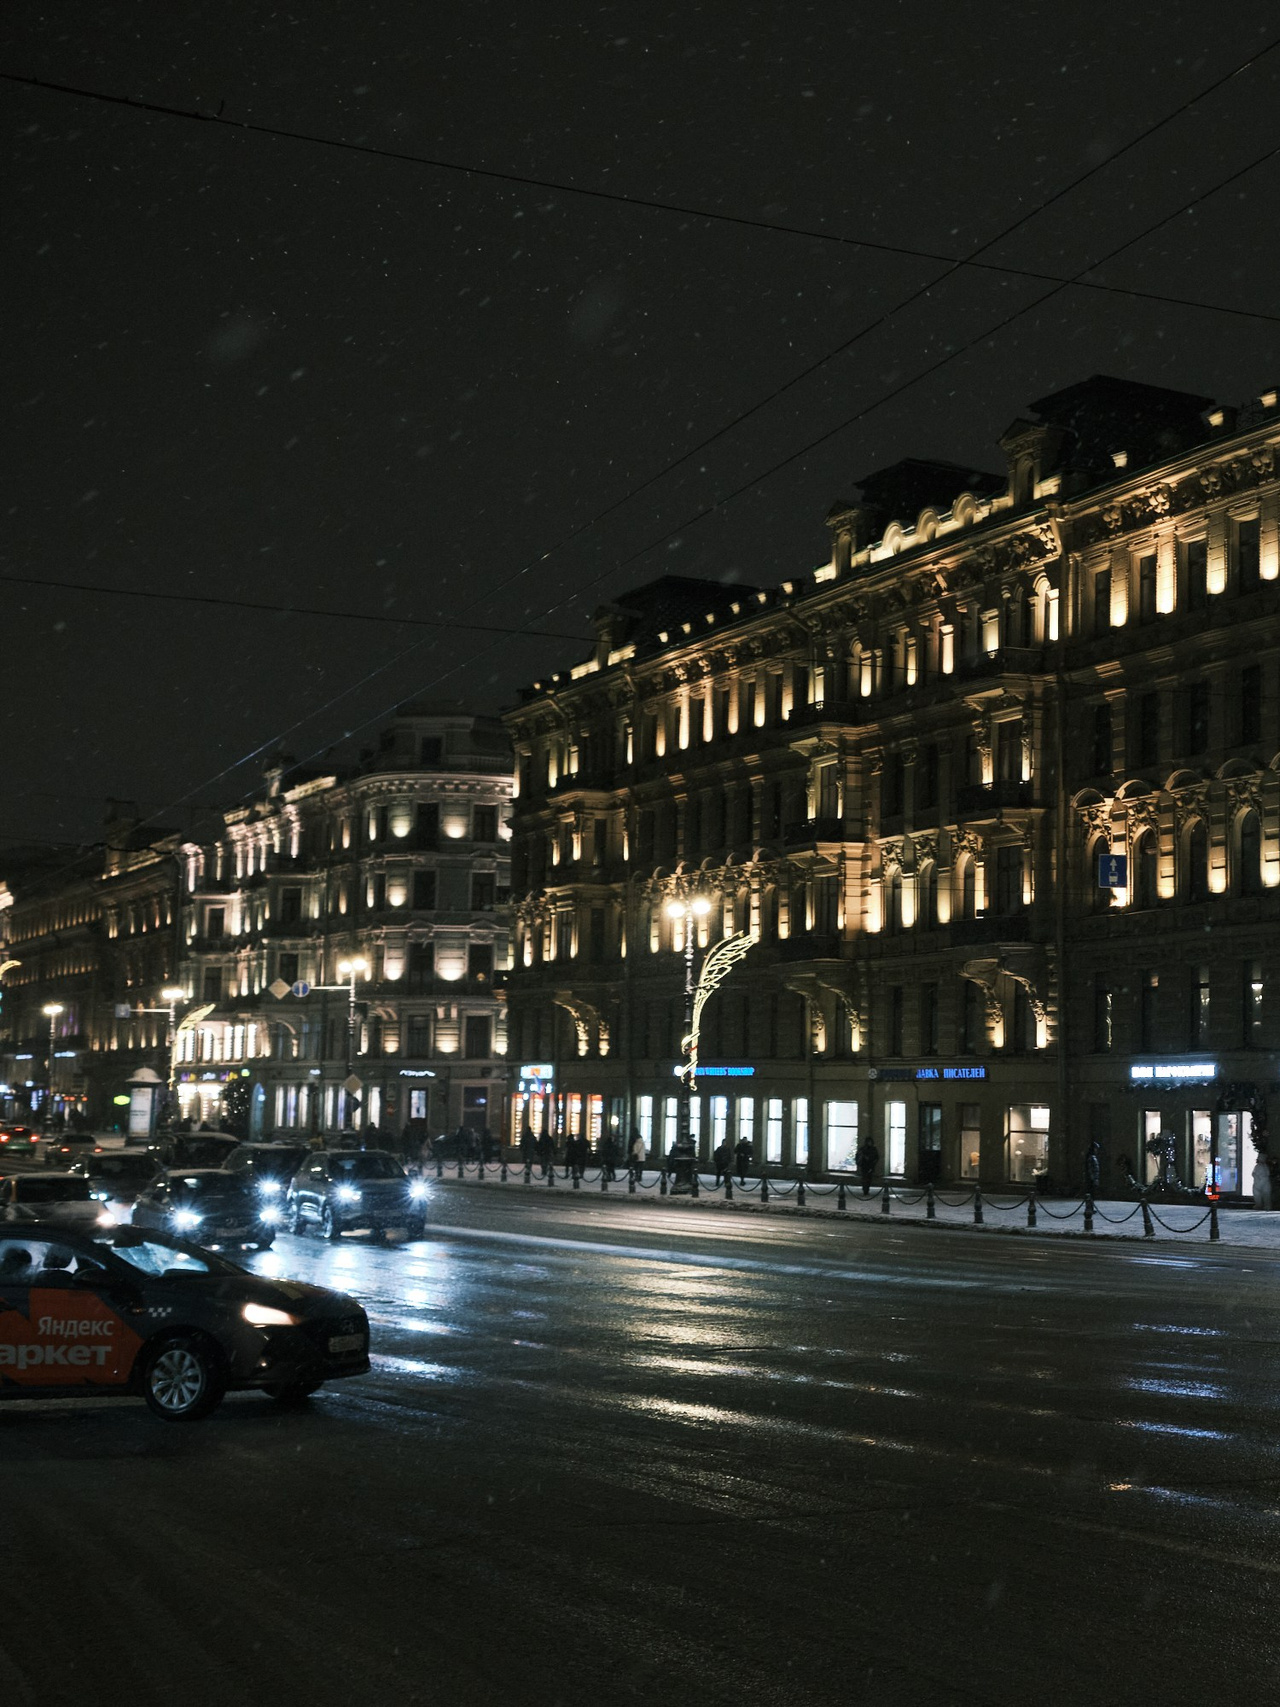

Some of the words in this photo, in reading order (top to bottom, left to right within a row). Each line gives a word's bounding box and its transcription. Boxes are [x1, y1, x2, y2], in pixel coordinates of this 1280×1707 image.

[916, 1068, 939, 1078] ЛАВКА
[943, 1065, 985, 1078] ПИСАТЕЛЕЙ
[37, 1315, 115, 1339] Яндекс
